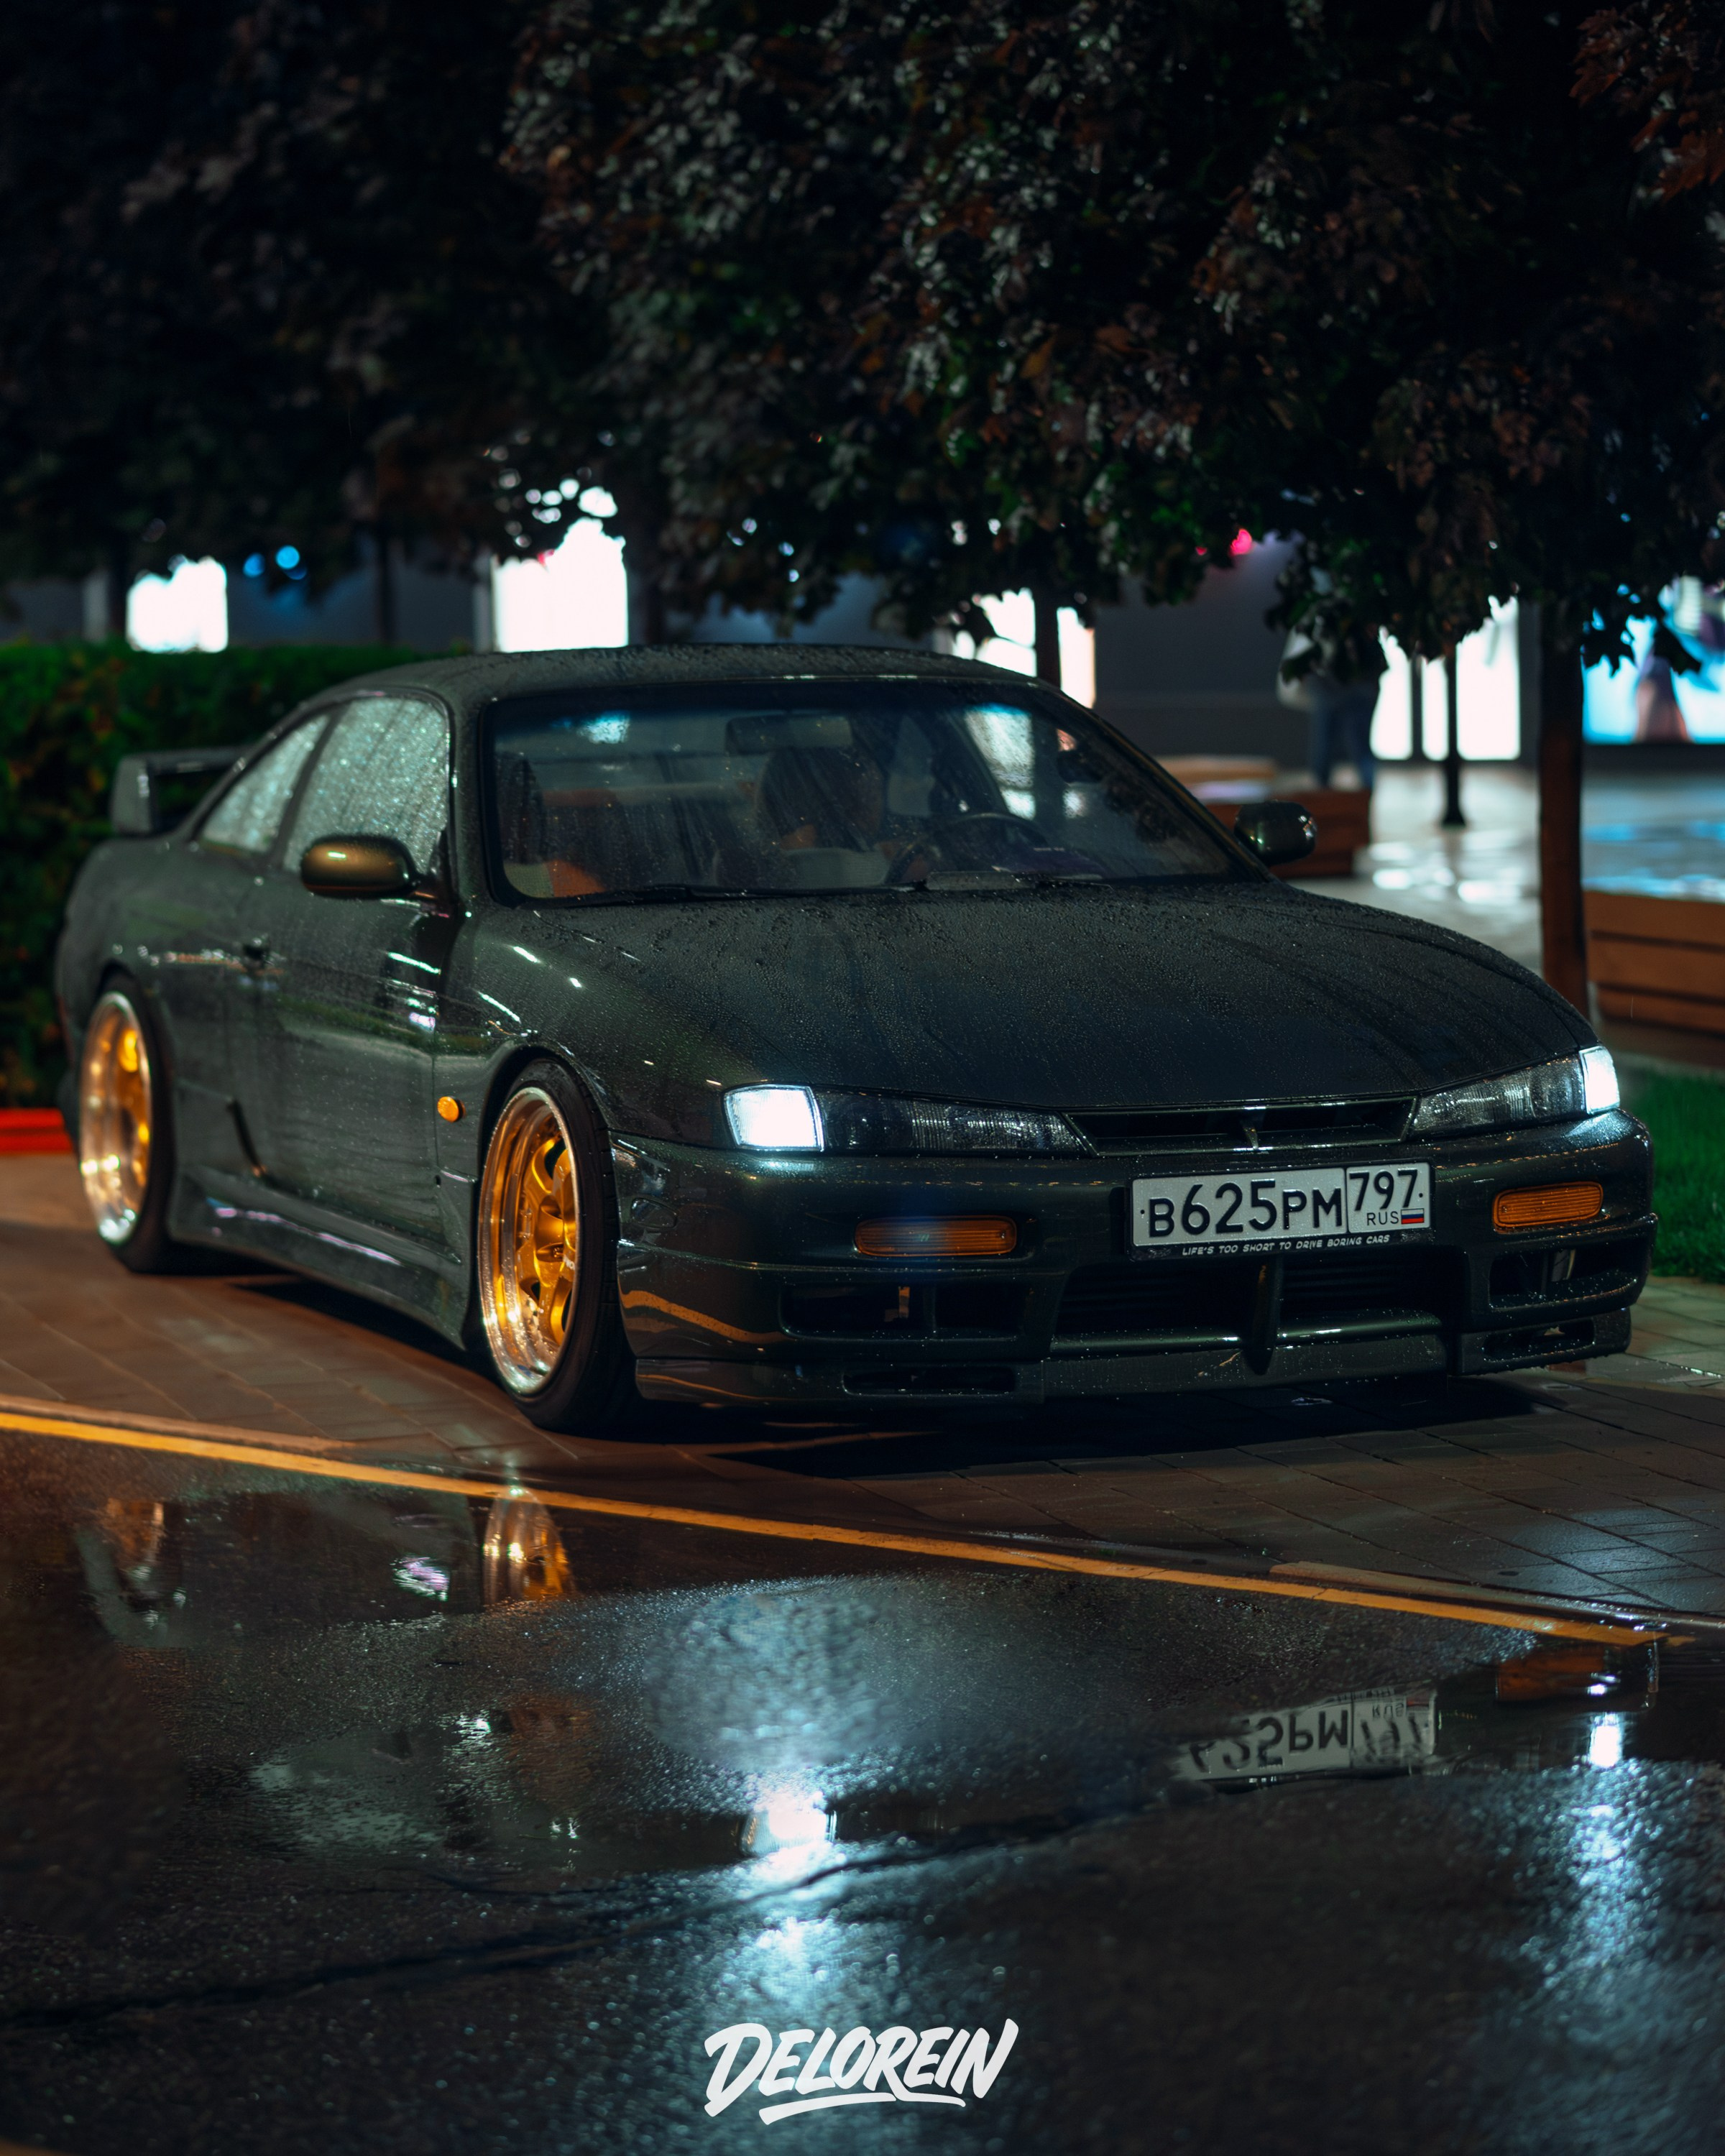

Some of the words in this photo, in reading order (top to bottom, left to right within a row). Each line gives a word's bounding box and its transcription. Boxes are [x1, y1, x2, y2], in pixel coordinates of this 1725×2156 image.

[1349, 1169, 1418, 1212] 797
[1366, 1211, 1399, 1226] RUS
[1182, 1246, 1214, 1256] LIFE'S
[1219, 1245, 1238, 1254] TOO
[1243, 1243, 1275, 1253] SHORT
[1279, 1241, 1292, 1250] TO
[1296, 1240, 1322, 1249] DRIVE
[1327, 1236, 1362, 1247] BORING
[1366, 1234, 1390, 1244] CARS
